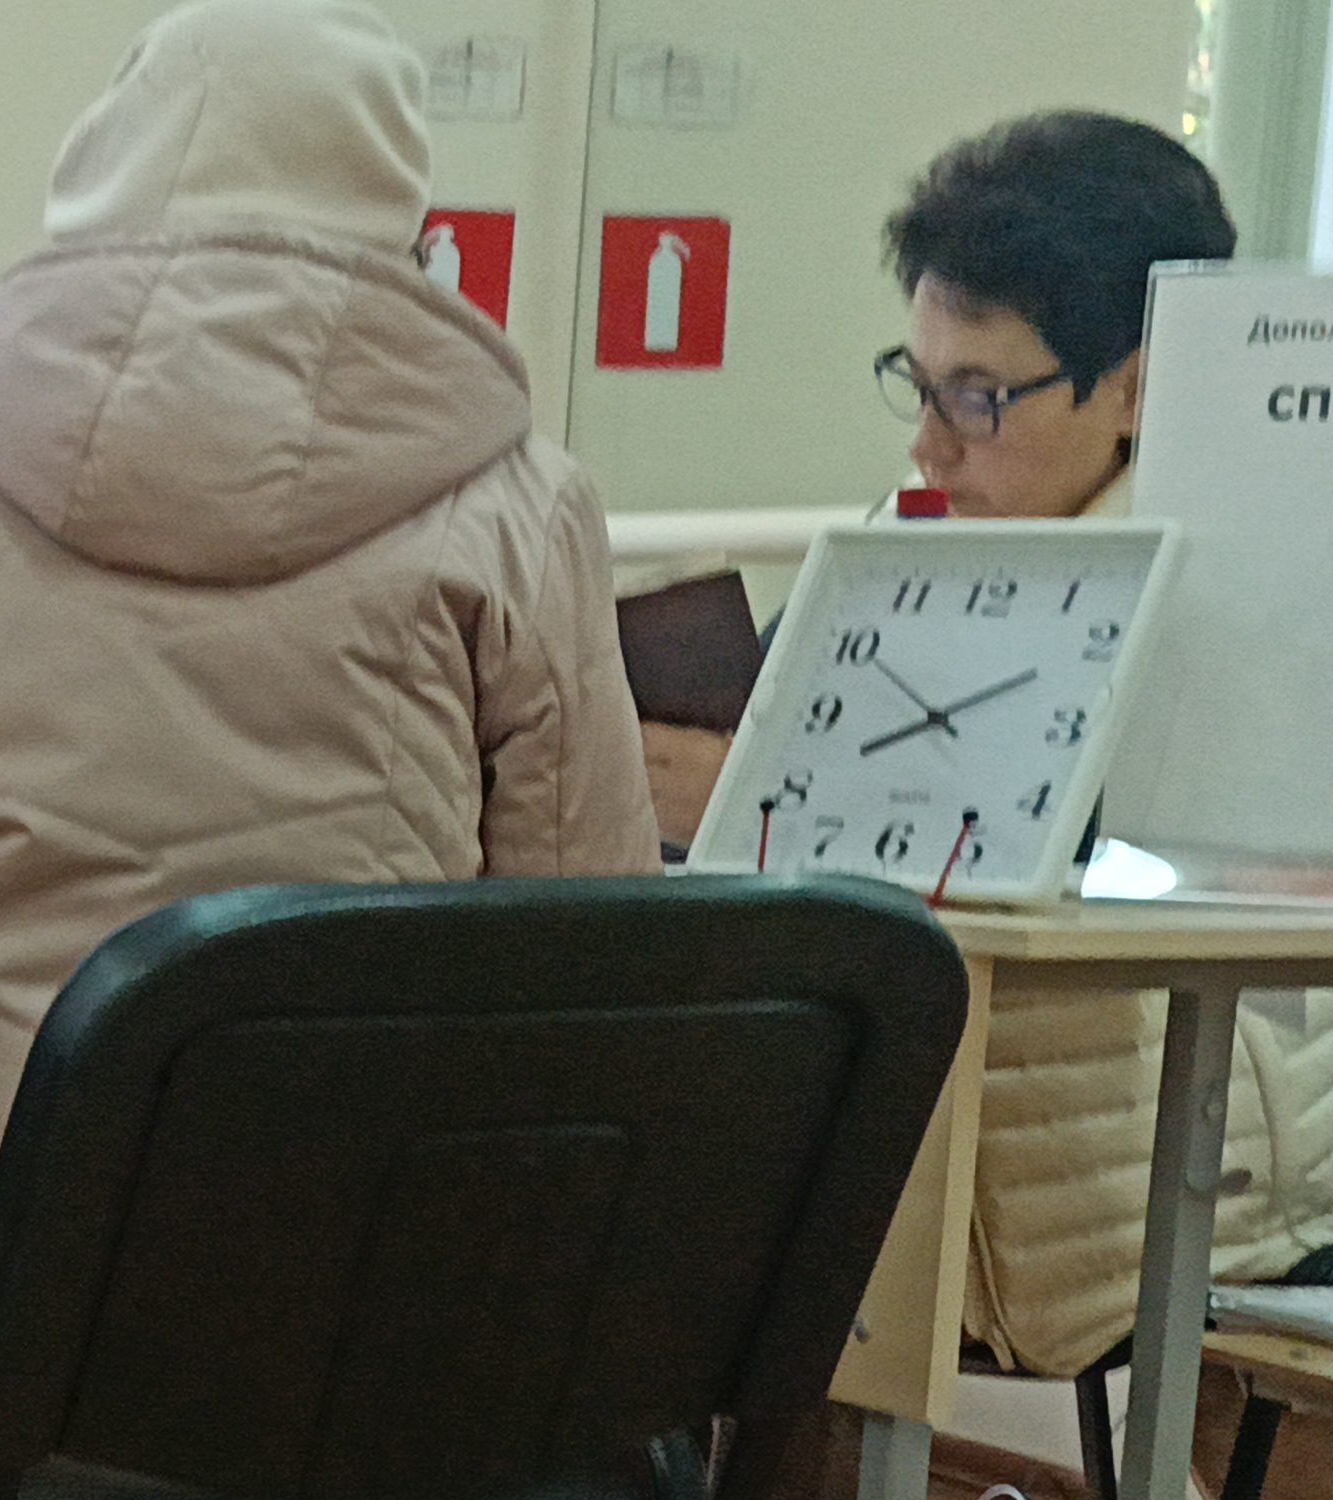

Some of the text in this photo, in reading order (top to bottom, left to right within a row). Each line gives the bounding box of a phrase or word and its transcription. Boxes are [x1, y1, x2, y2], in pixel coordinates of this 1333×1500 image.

[1247, 314, 1333, 347] Допо
[893, 577, 931, 613] 11
[965, 577, 1018, 618] 12
[1060, 577, 1081, 615] 1
[835, 627, 881, 667] 10
[1081, 621, 1120, 662] 2
[805, 693, 843, 733] 9
[1044, 706, 1086, 747] 3
[775, 768, 814, 811] 8
[814, 814, 845, 858] 7
[874, 819, 915, 864] 6
